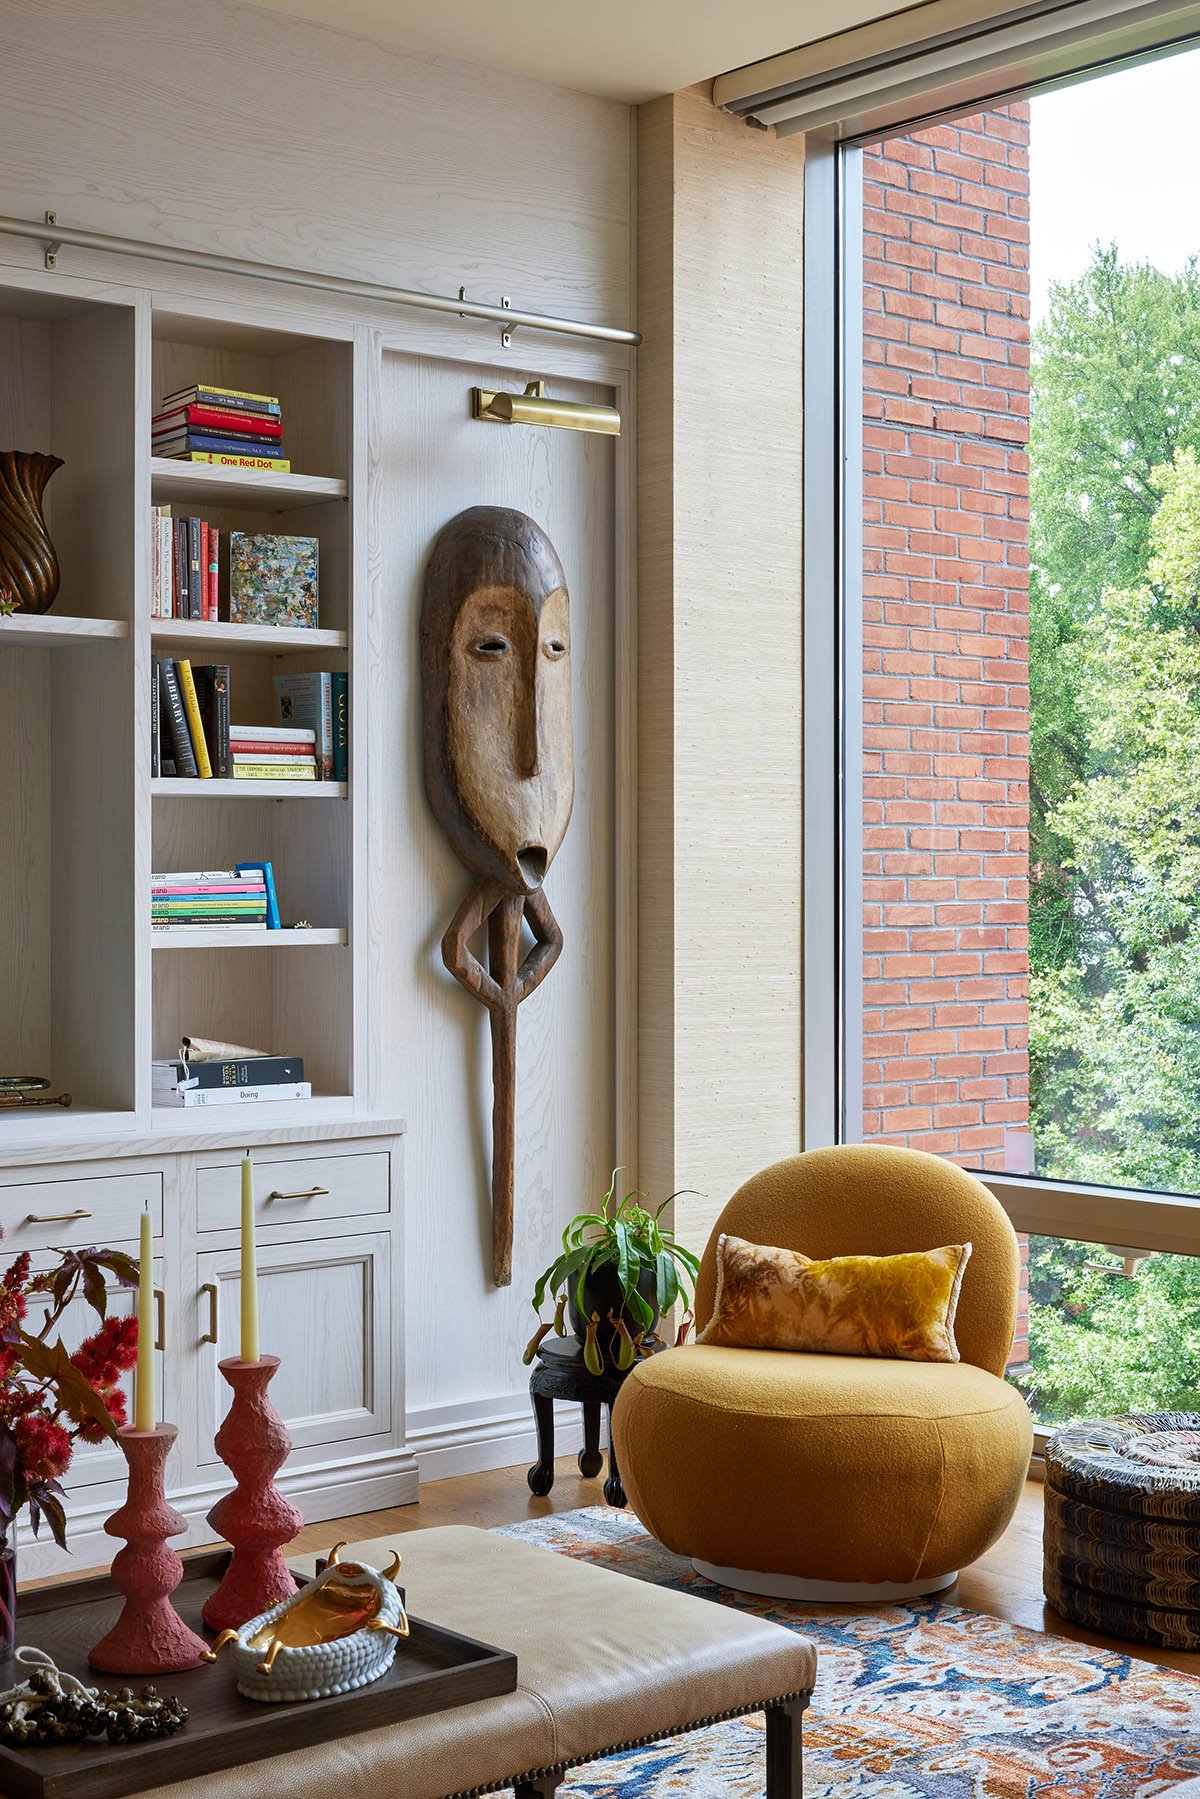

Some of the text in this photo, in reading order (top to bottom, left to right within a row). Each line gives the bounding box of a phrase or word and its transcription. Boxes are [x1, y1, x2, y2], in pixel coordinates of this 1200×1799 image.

[221, 457, 273, 469] One Red Dot
[166, 672, 184, 724] LIBRARY
[188, 689, 197, 713] Malala
[240, 1090, 259, 1099] Doing
